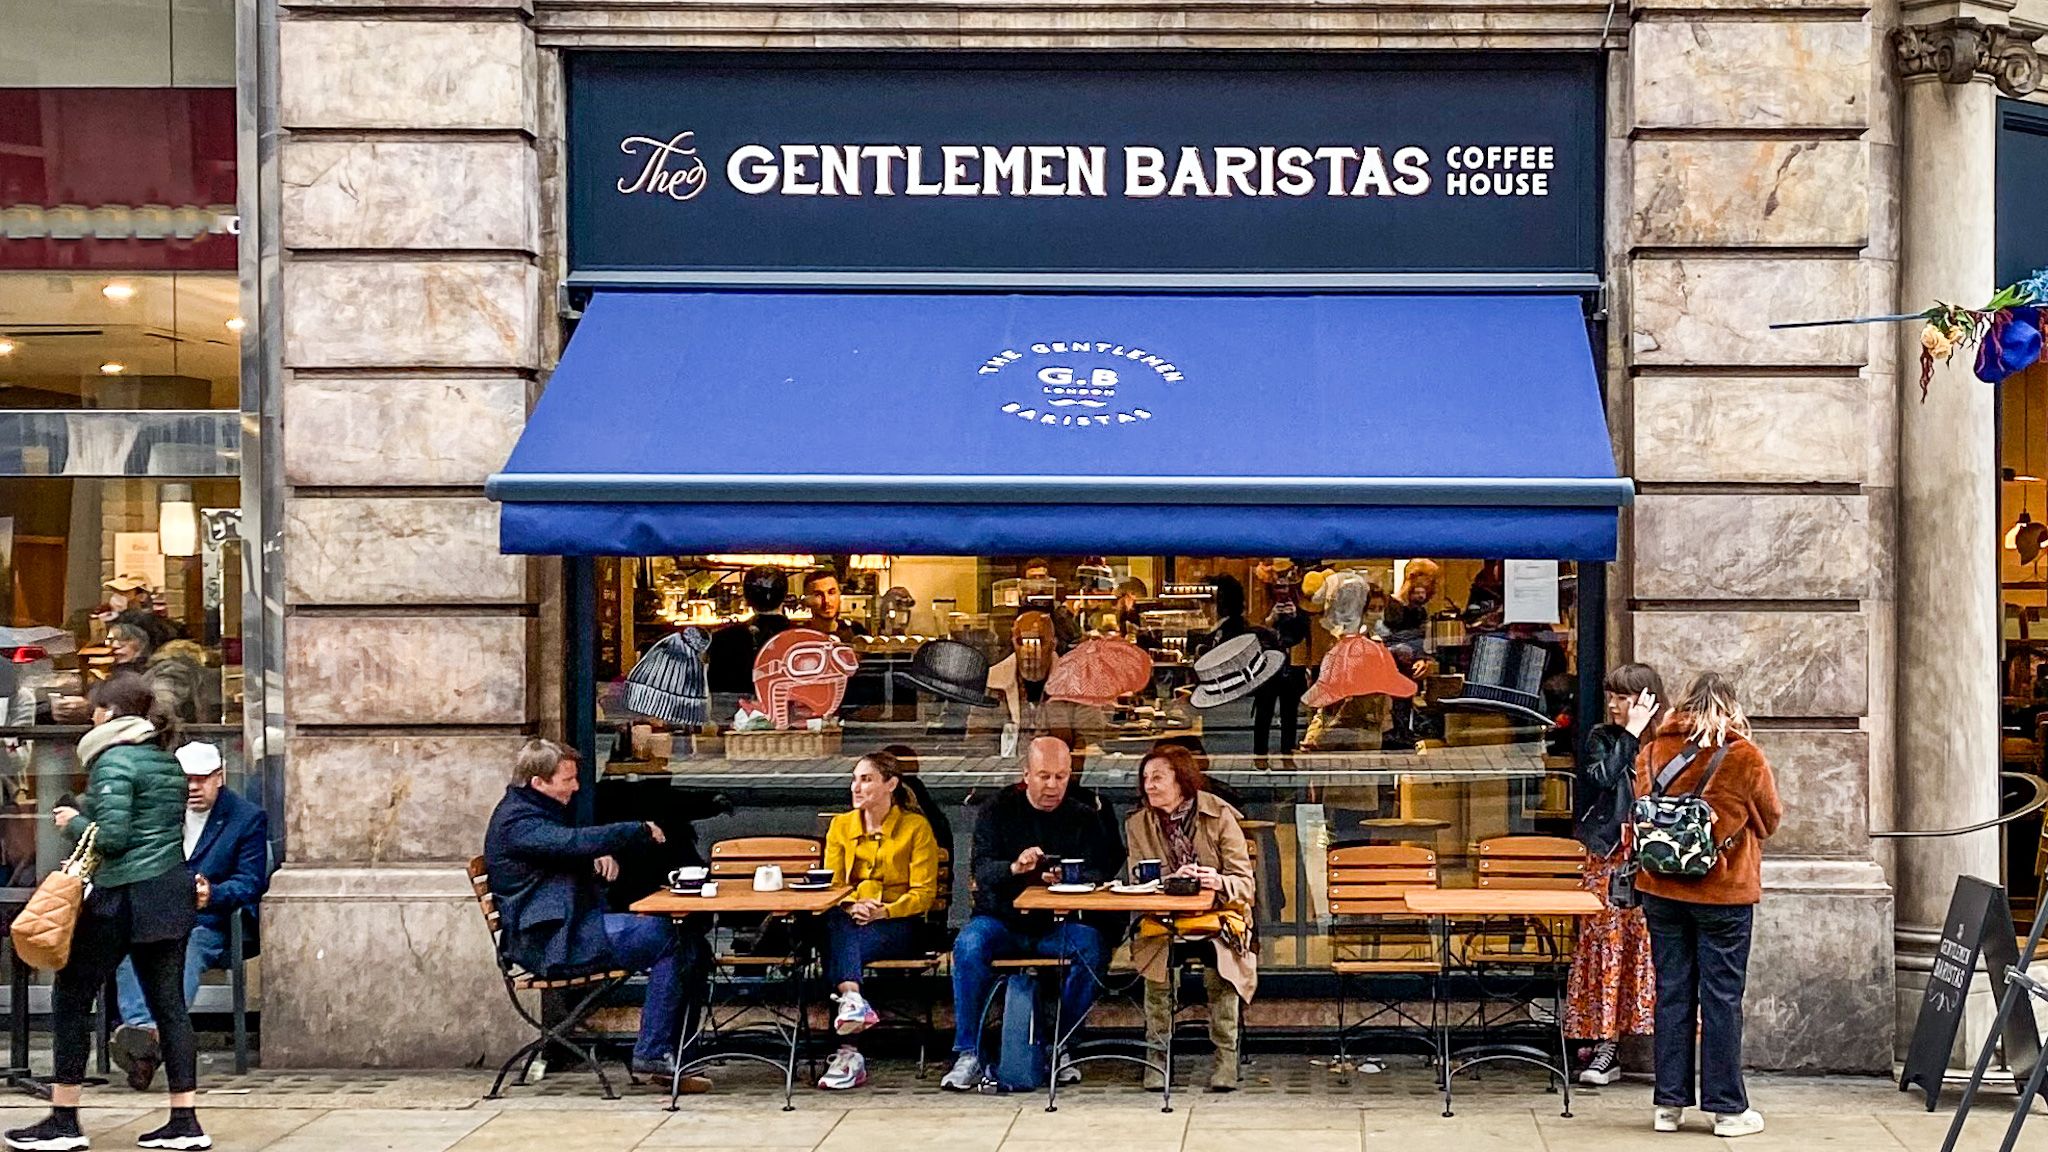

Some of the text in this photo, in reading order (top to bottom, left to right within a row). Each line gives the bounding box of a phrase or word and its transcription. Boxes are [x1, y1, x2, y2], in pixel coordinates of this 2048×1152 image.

[618, 131, 1431, 200] The GENTLEMEN BARISTAS
[1447, 146, 1554, 170] COFFEE
[1447, 173, 1548, 196] HOUSE
[978, 341, 1184, 382] THE GENTLEMEN
[1043, 386, 1115, 397] LONDON
